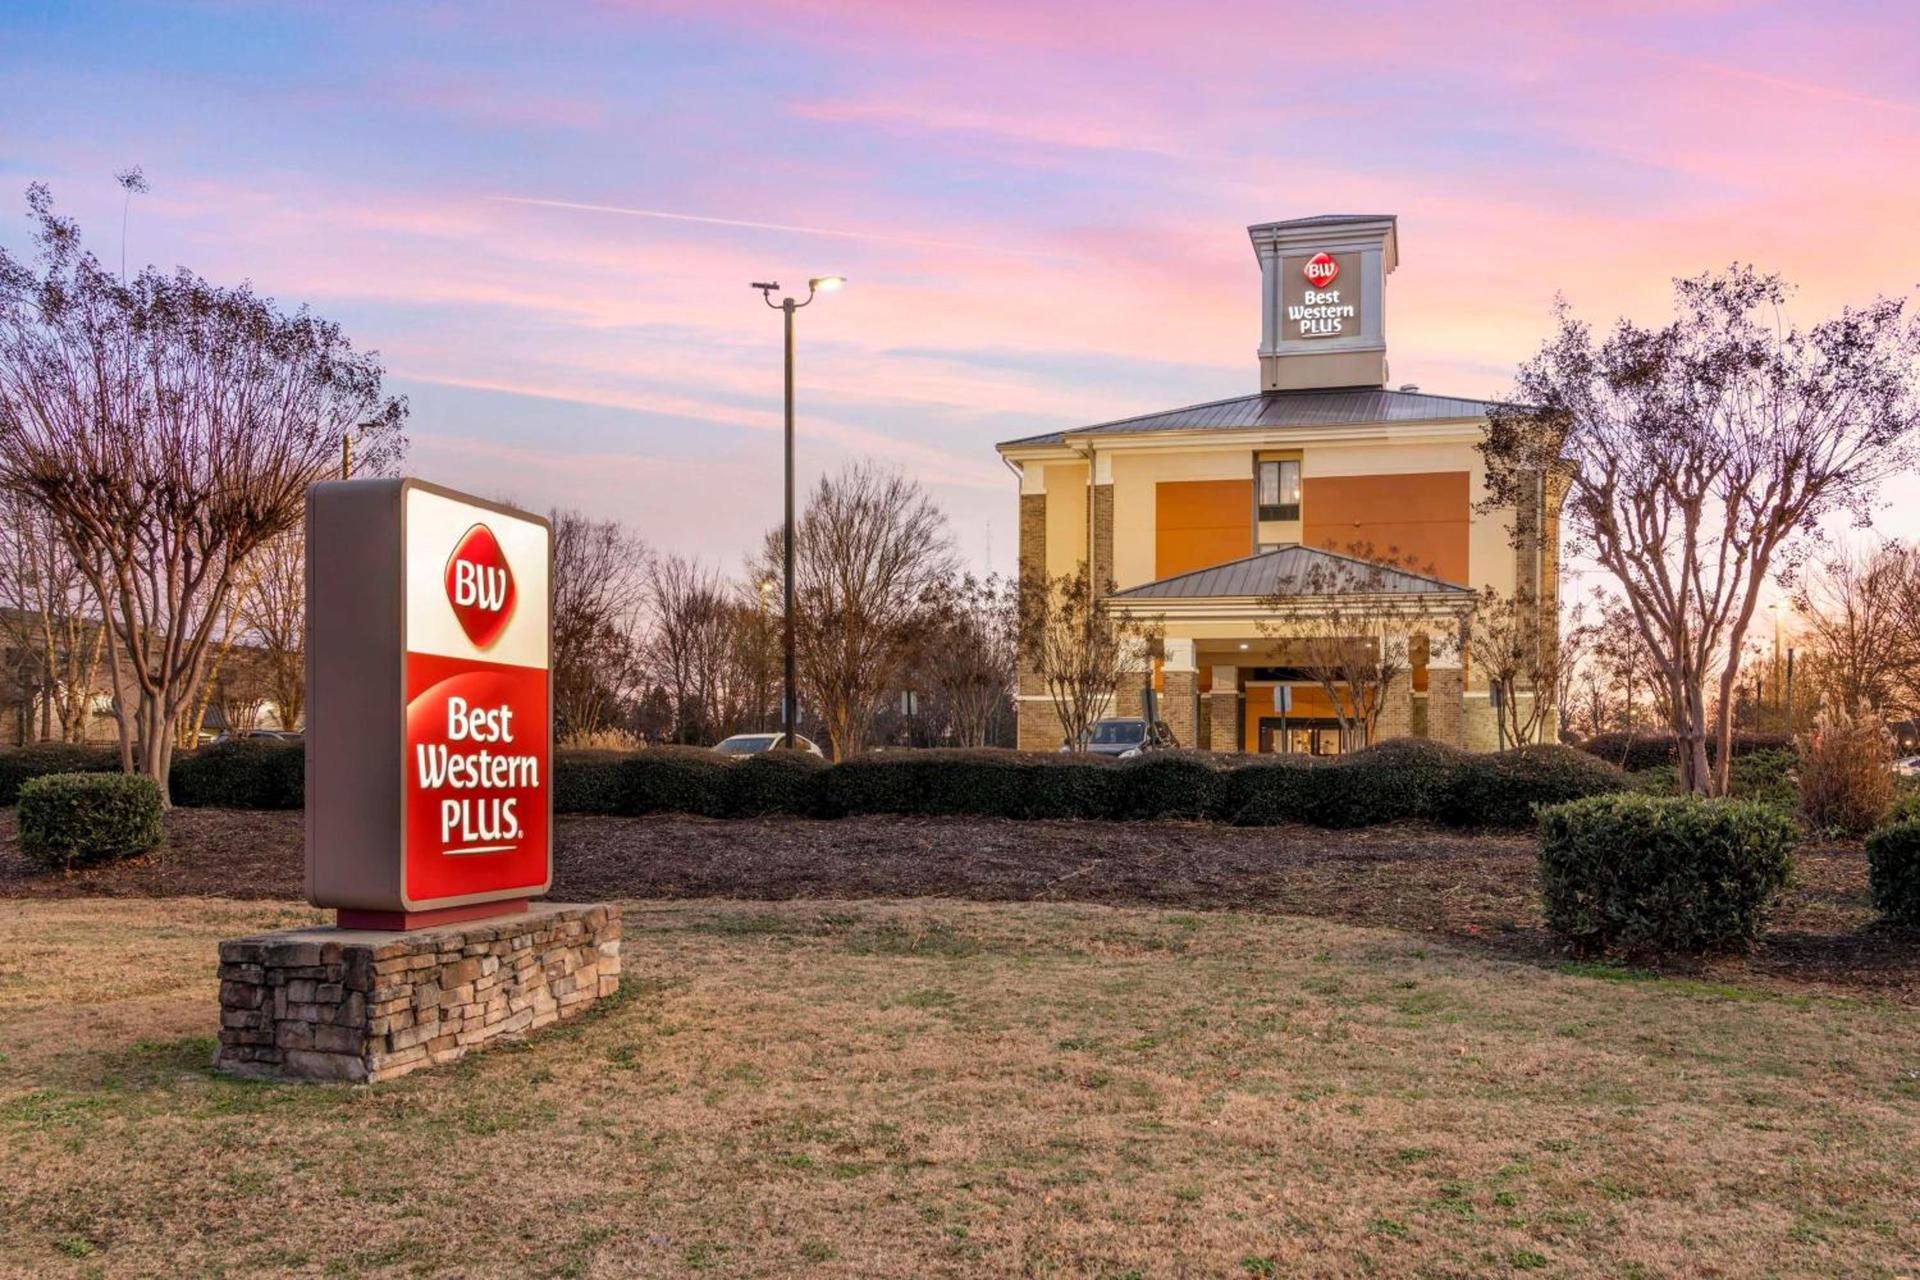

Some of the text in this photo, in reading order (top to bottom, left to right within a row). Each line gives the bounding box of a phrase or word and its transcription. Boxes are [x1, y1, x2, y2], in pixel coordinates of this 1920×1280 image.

[1308, 262, 1335, 278] BW
[1305, 290, 1340, 305] Best
[1288, 305, 1354, 320] Western
[1300, 318, 1342, 333] PLUS
[455, 559, 507, 612] BW
[448, 696, 514, 743] Best
[416, 743, 539, 789] Western
